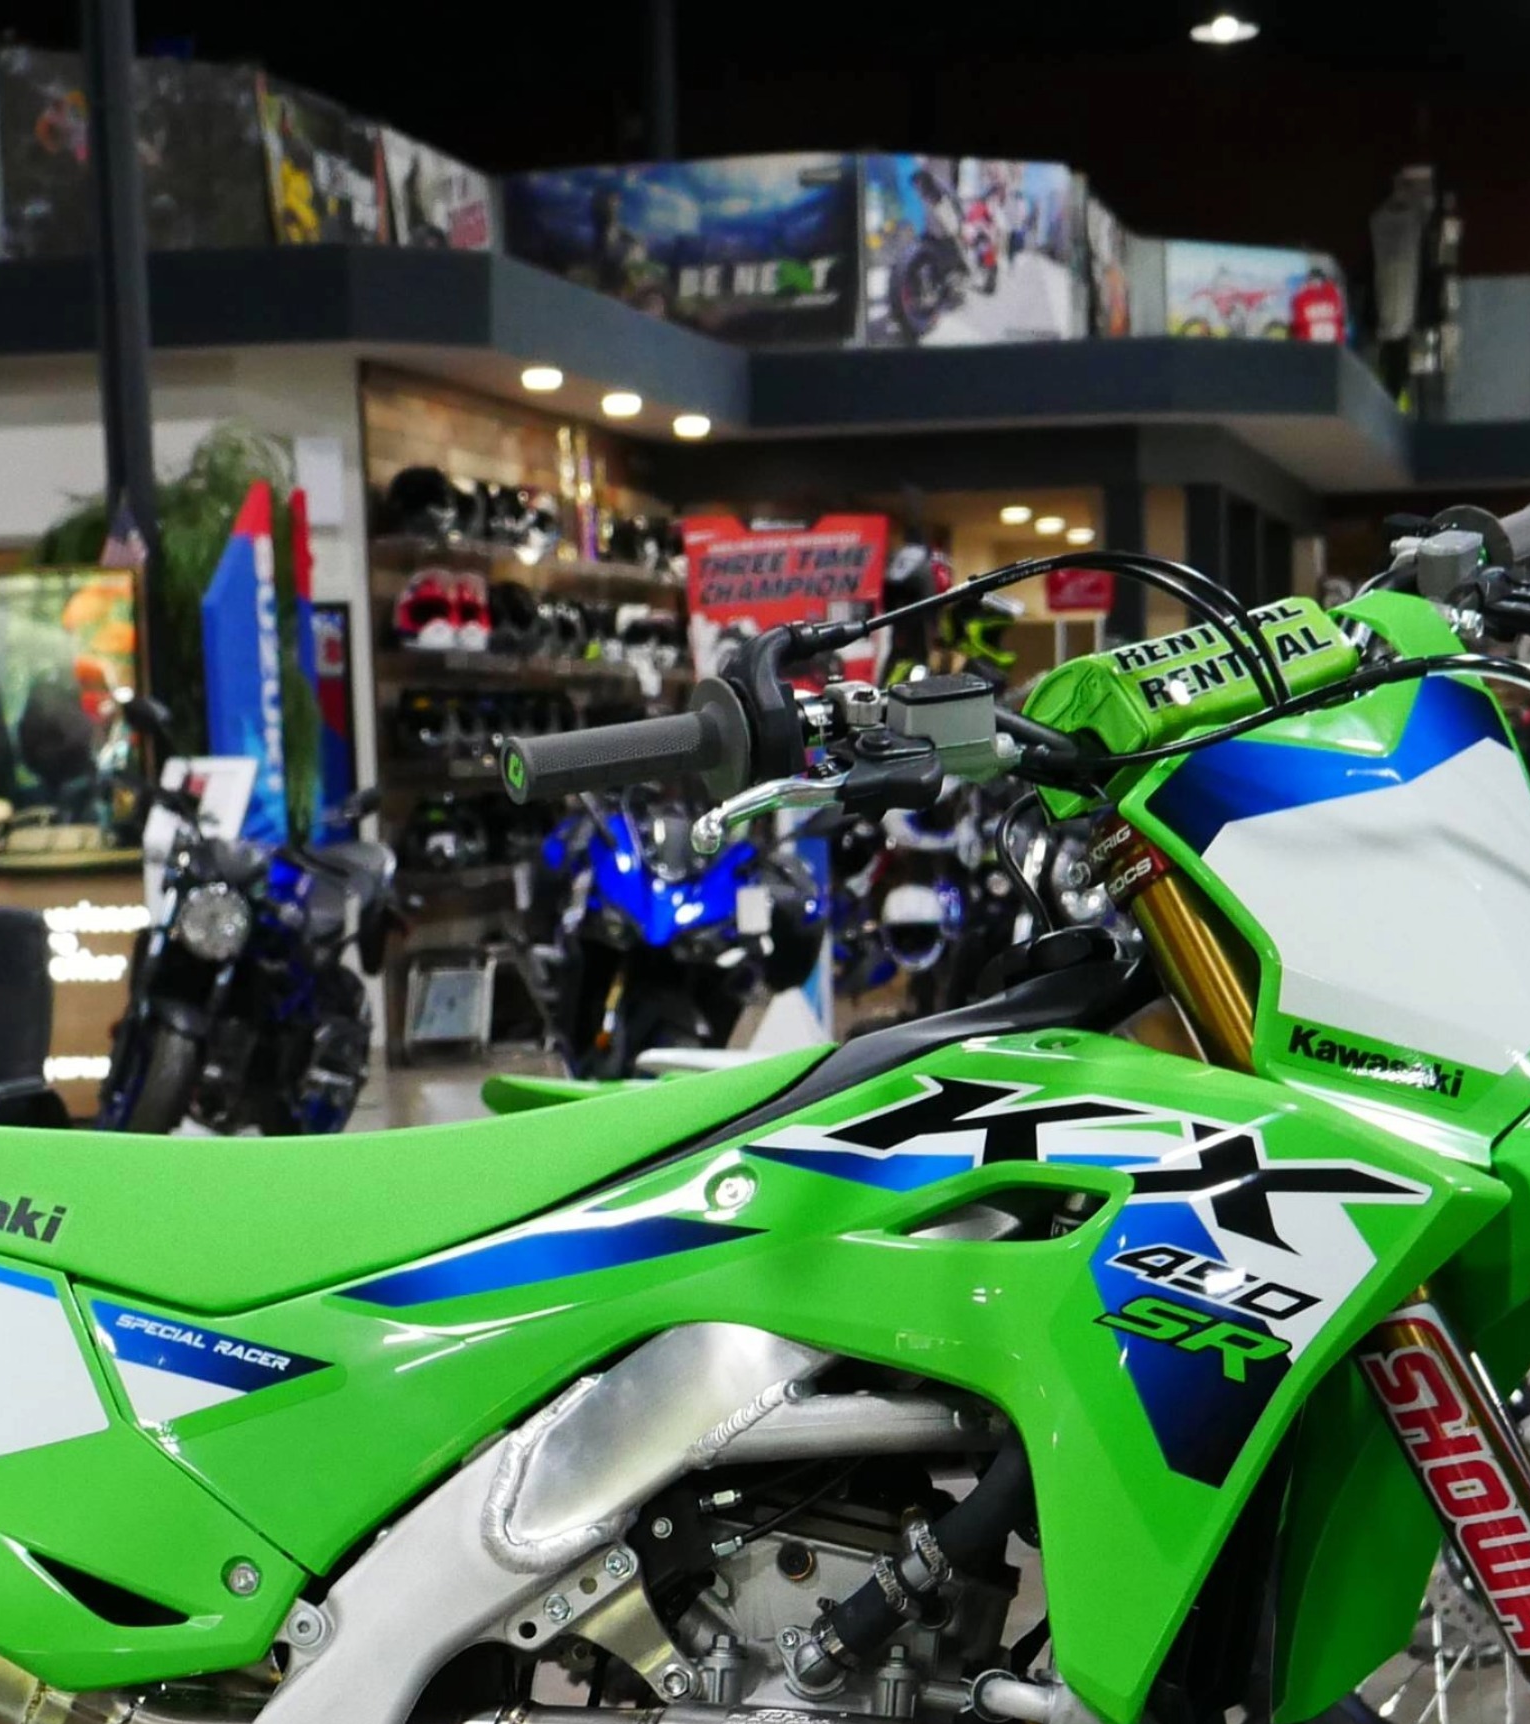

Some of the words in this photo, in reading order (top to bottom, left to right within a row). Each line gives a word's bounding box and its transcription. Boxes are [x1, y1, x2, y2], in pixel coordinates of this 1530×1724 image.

[700, 550, 787, 577] THREE
[797, 544, 875, 570] TIME
[700, 571, 861, 604] CHAMPION
[821, 1074, 1429, 1256] KX
[1111, 1244, 1323, 1320] 450
[115, 1313, 206, 1349] SPECIAL
[213, 1339, 292, 1372] RACER
[1093, 1296, 1295, 1384] SR
